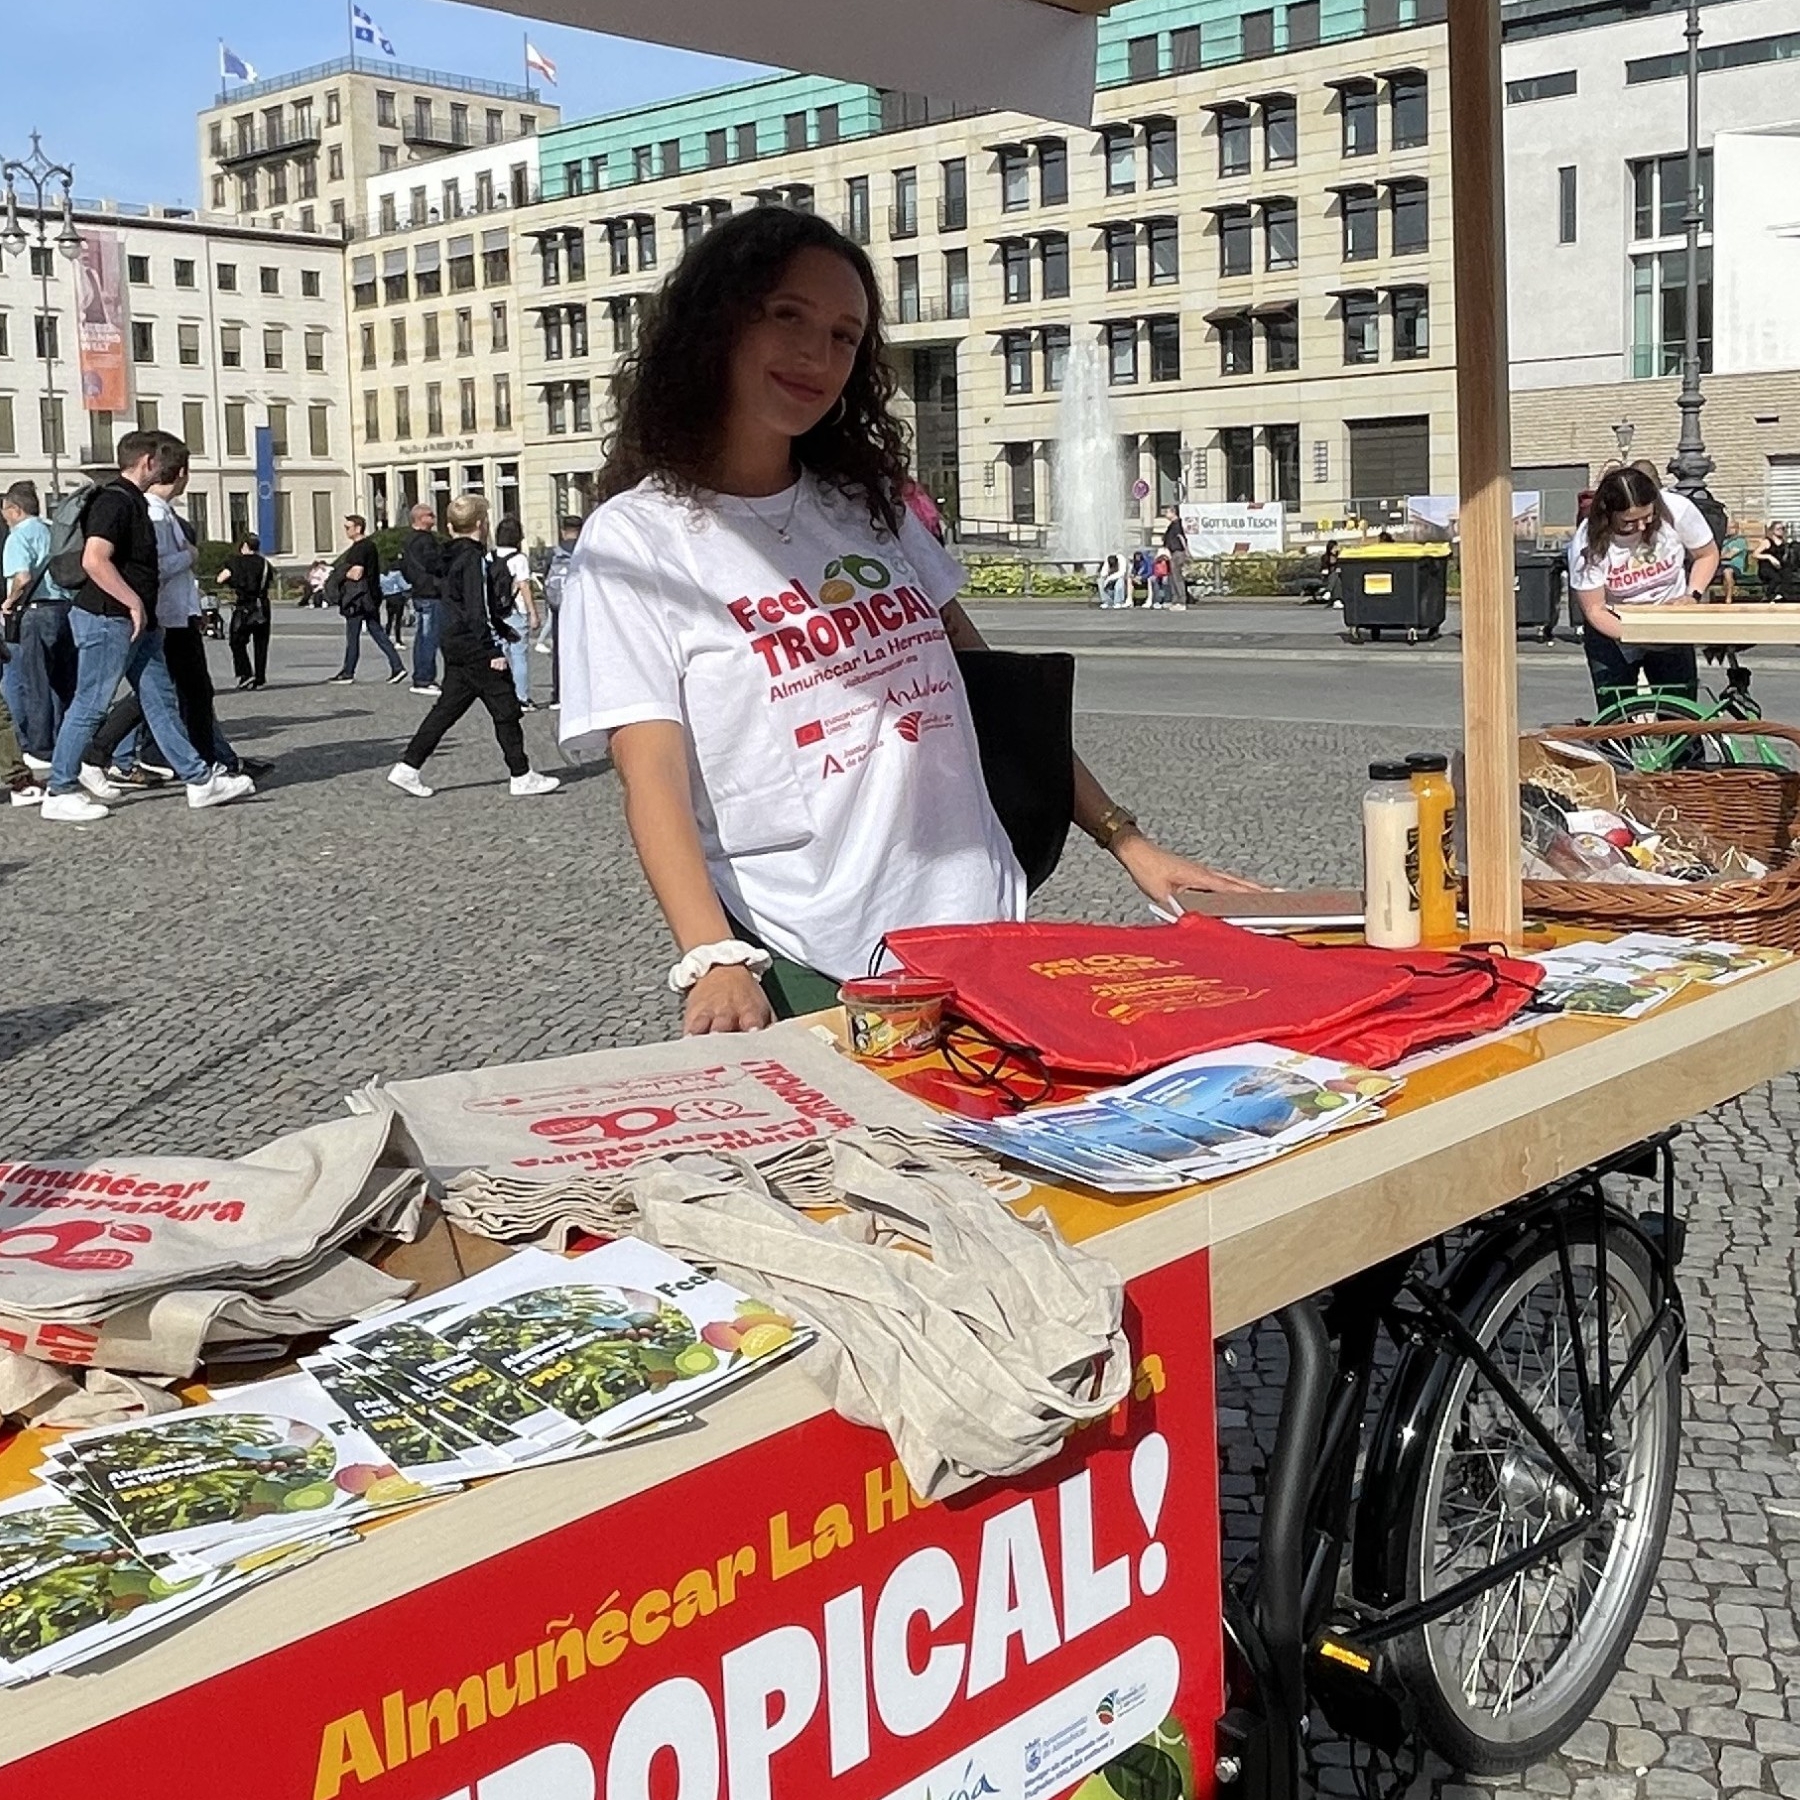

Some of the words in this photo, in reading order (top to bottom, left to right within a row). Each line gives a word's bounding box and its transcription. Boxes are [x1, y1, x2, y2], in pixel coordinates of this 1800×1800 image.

[727, 578, 818, 633] Feel
[864, 648, 886, 664] La
[8, 1188, 246, 1222] Herradura
[438, 1431, 1171, 1800] OPICAL!
[313, 1546, 756, 1800] Almuñécar
[767, 1501, 854, 1582] La
